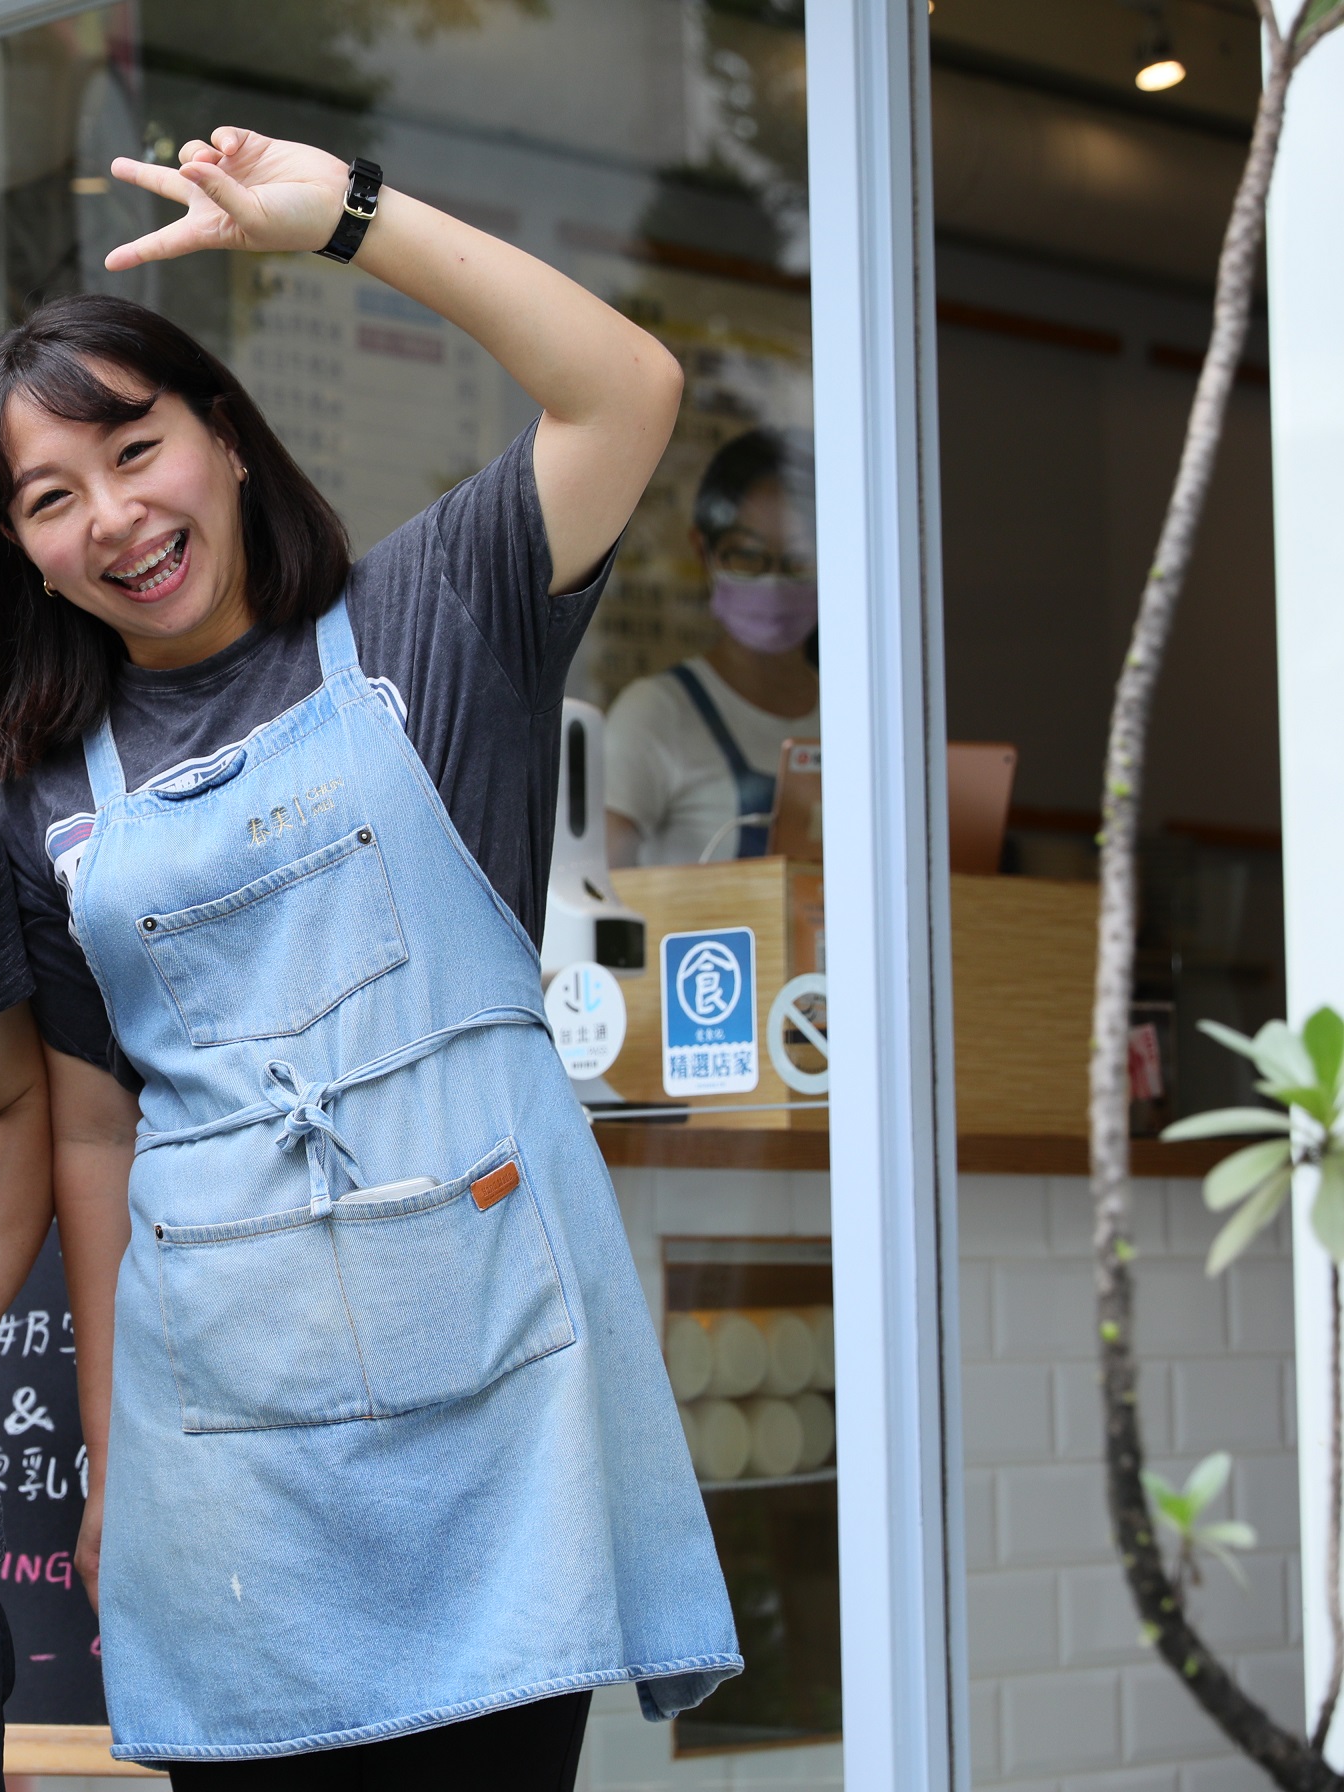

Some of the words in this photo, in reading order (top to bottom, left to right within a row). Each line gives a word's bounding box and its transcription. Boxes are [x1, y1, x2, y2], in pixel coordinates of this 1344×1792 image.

[247, 806, 293, 848] 春美
[670, 1050, 752, 1079] 精選店家
[3, 1386, 55, 1436] &
